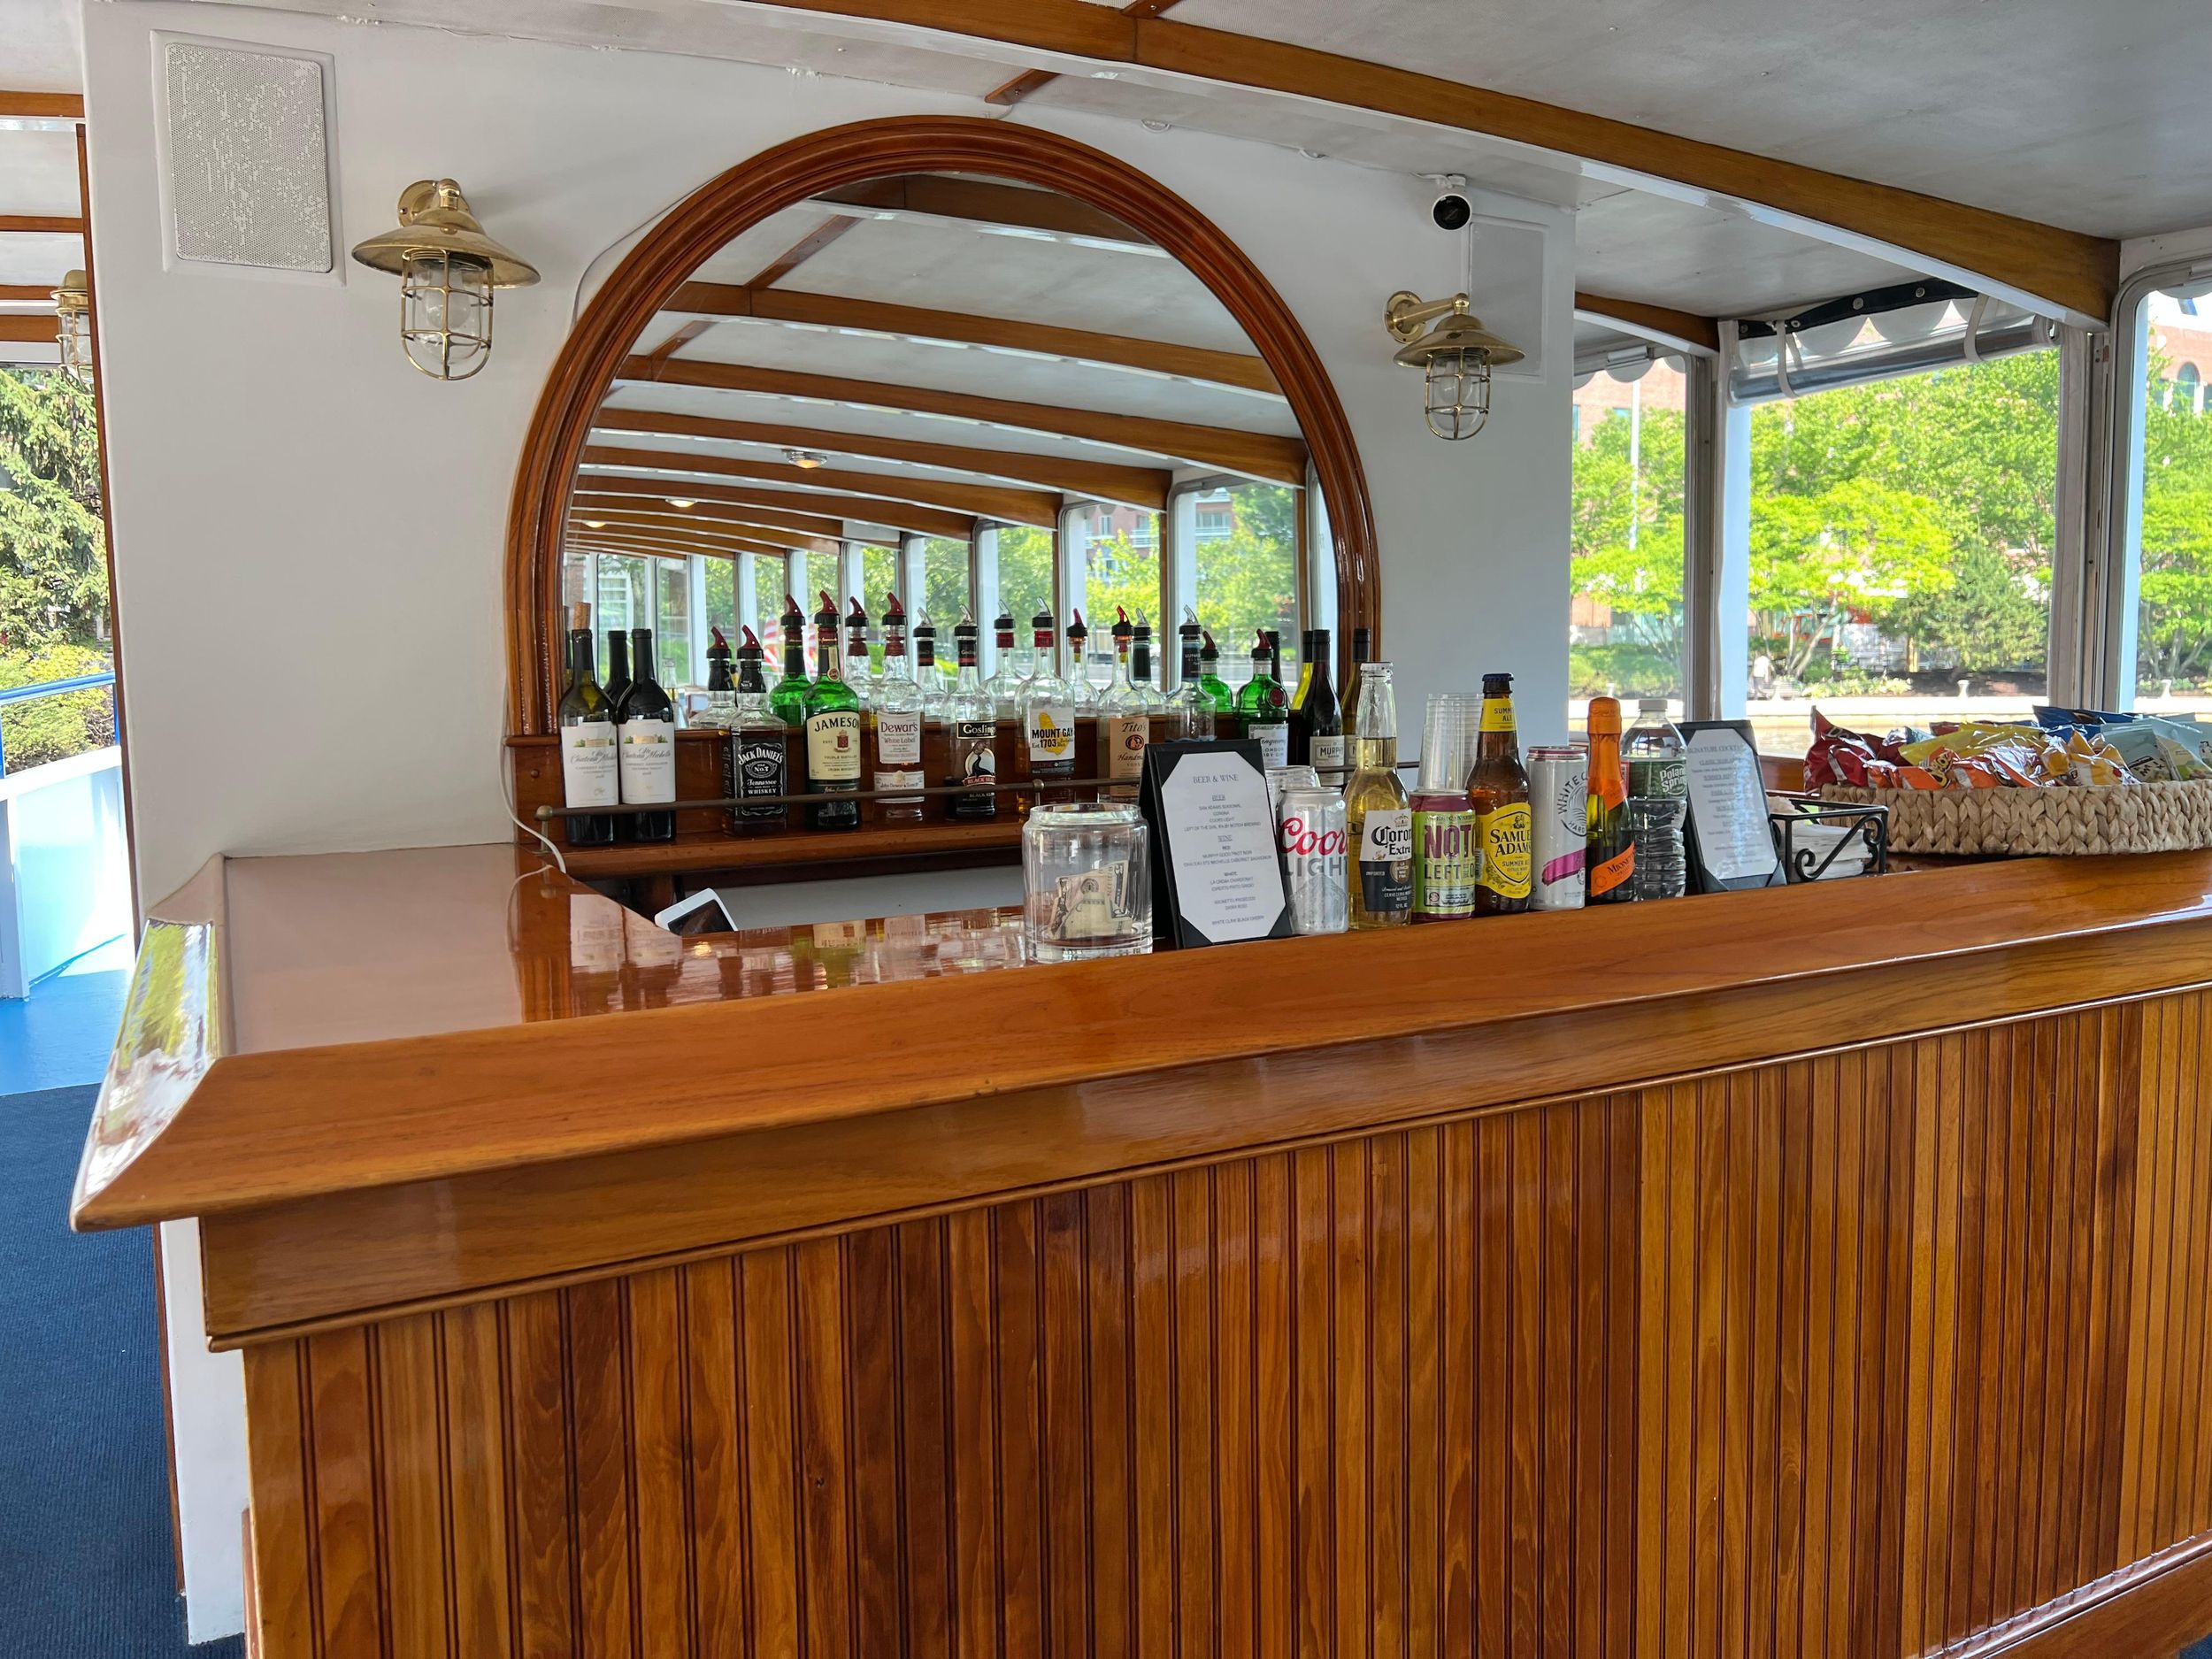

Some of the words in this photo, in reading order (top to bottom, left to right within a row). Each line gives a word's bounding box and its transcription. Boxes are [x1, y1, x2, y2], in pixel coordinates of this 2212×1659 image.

[880, 721, 918, 733] Dewar's
[1032, 728, 1061, 739] MOUNT
[1062, 727, 1073, 737] GAY
[1122, 721, 1147, 733] Tito's
[1040, 739, 1056, 748] 1703
[738, 750, 756, 765] JACK
[757, 748, 784, 764] DANIEL'S
[1557, 775, 1579, 815] WHITE
[1568, 821, 1586, 833] HARD
[1278, 817, 1348, 856] Coor
[1490, 828, 1531, 843] SAMUE
[1495, 842, 1531, 857] ADAM
[1285, 856, 1348, 877] LIGH
[1425, 864, 1461, 879] LEFT
